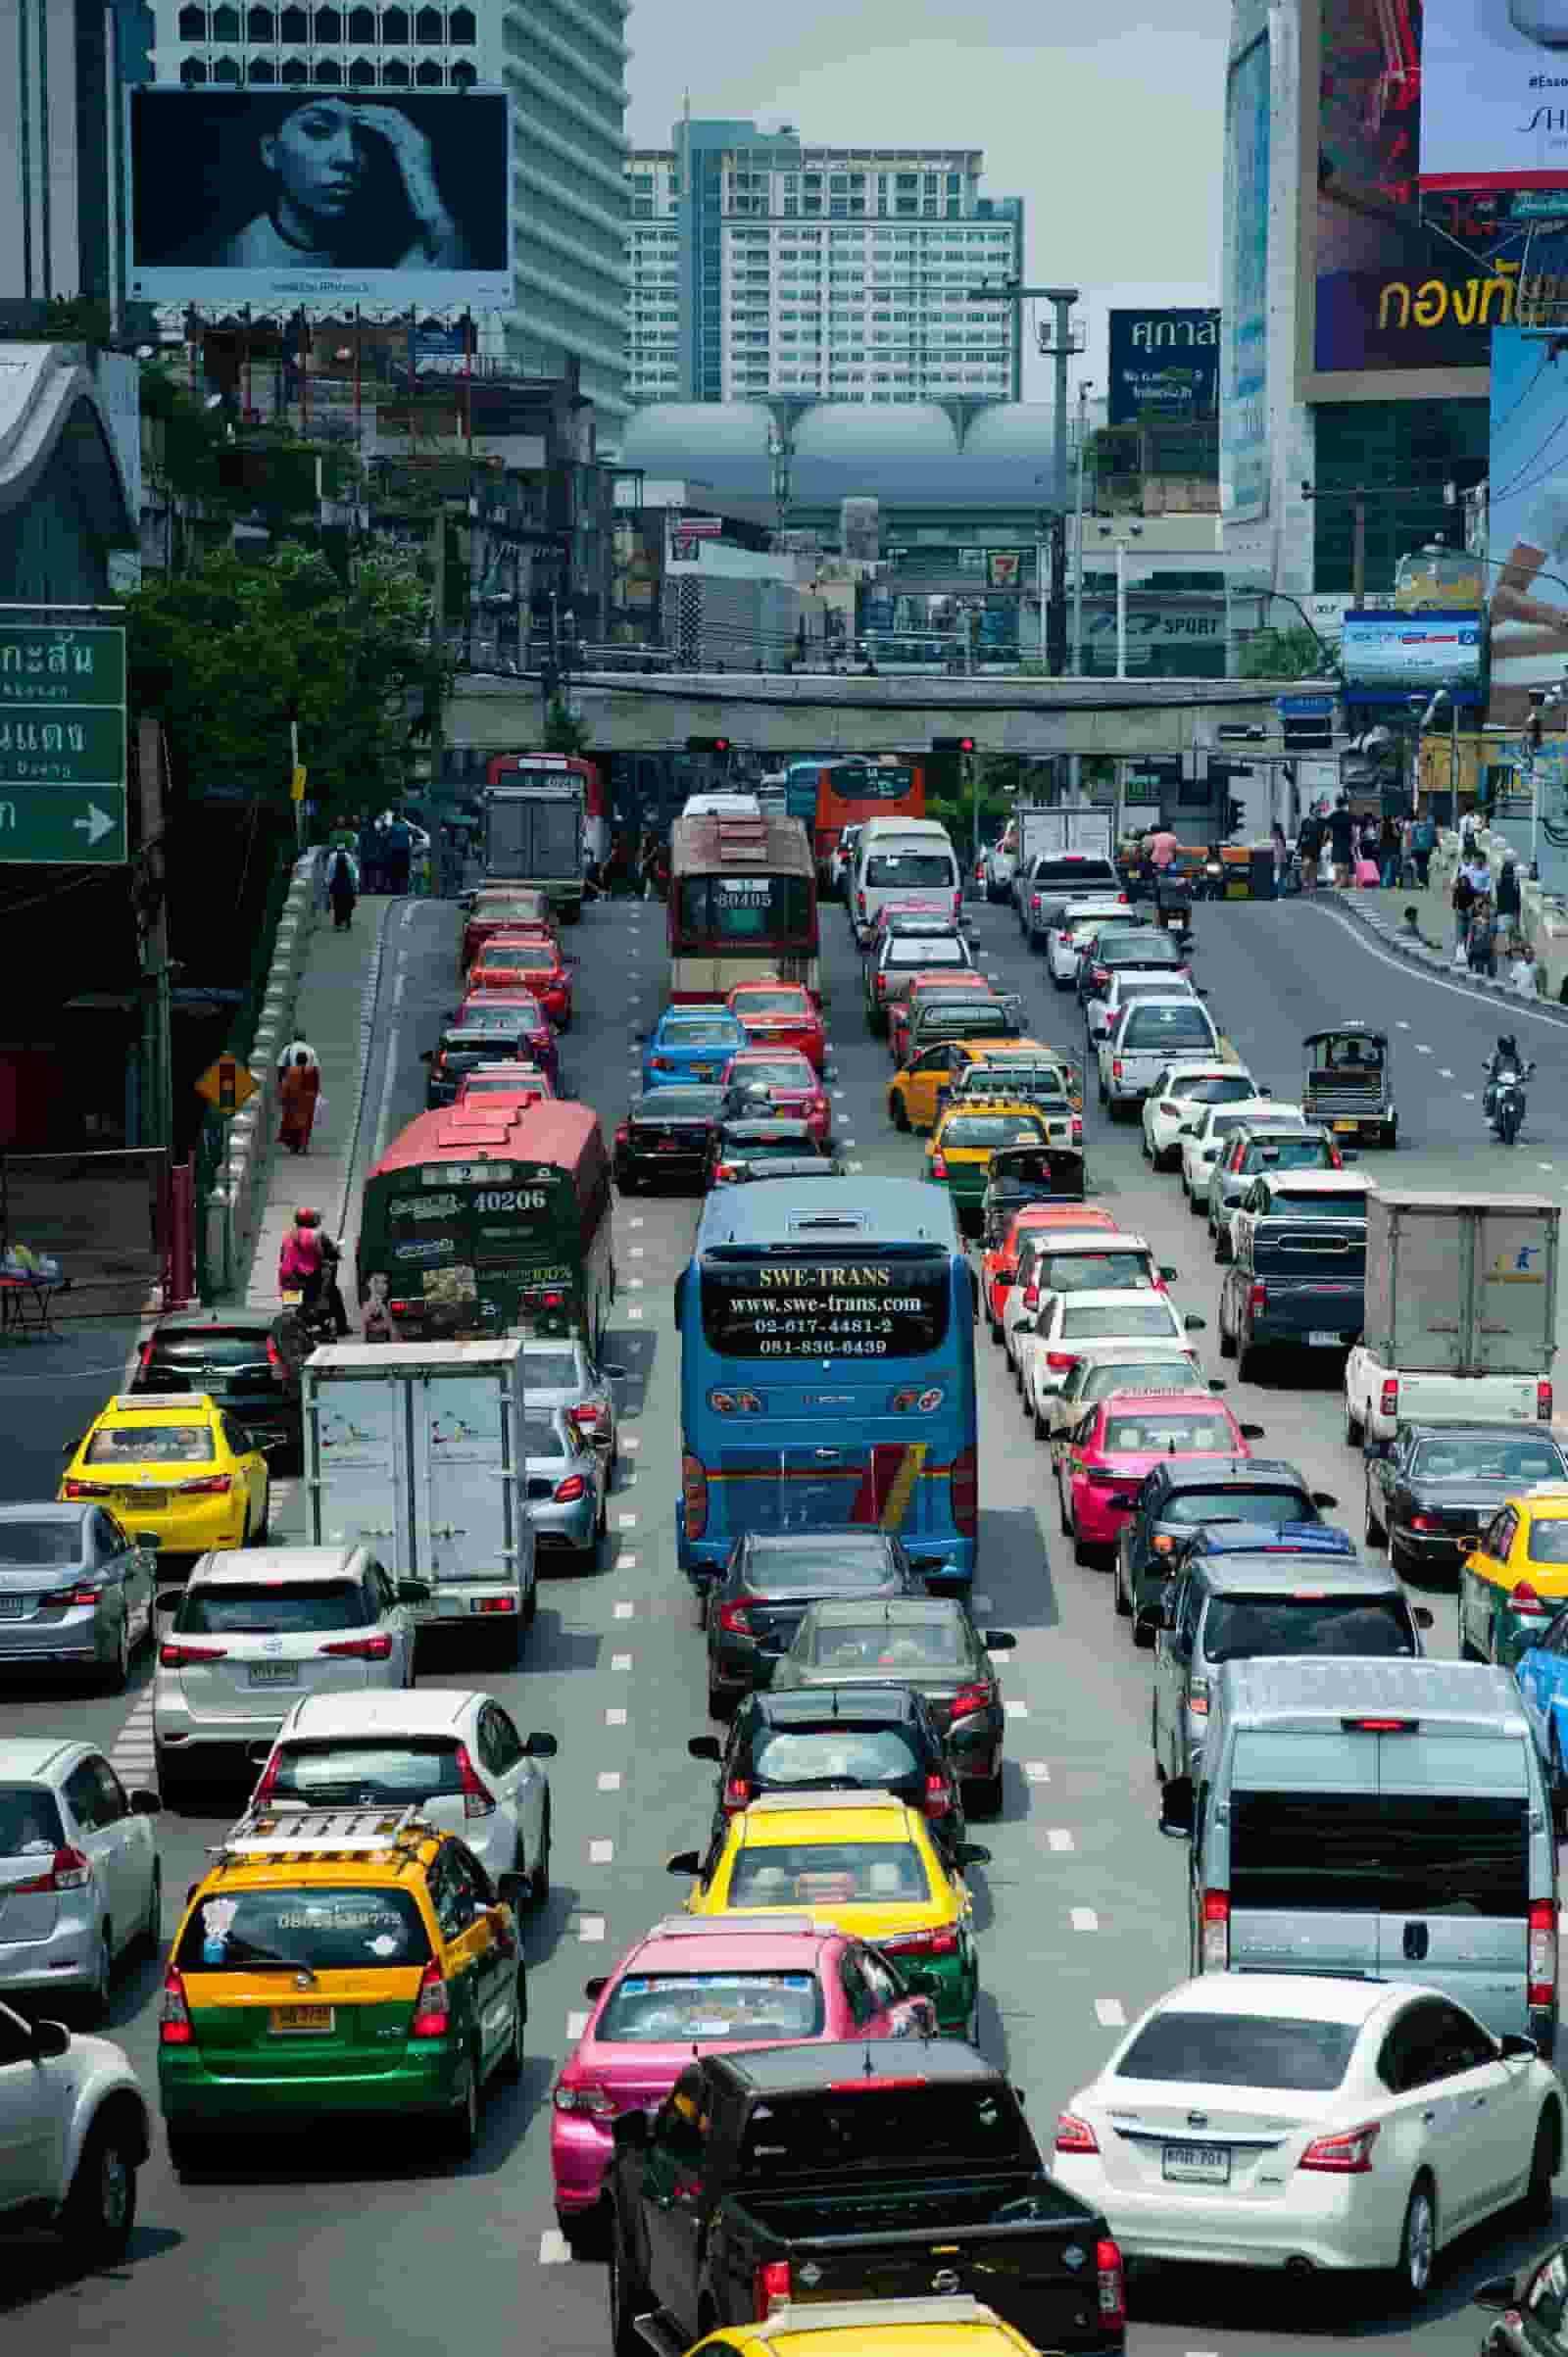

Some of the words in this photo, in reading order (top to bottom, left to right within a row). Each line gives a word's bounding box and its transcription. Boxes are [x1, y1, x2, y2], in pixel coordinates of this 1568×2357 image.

[474, 1192, 547, 1211] 40206
[760, 1267, 890, 1287] SWE-TRANS
[729, 1294, 921, 1312] www.swe-trans.com
